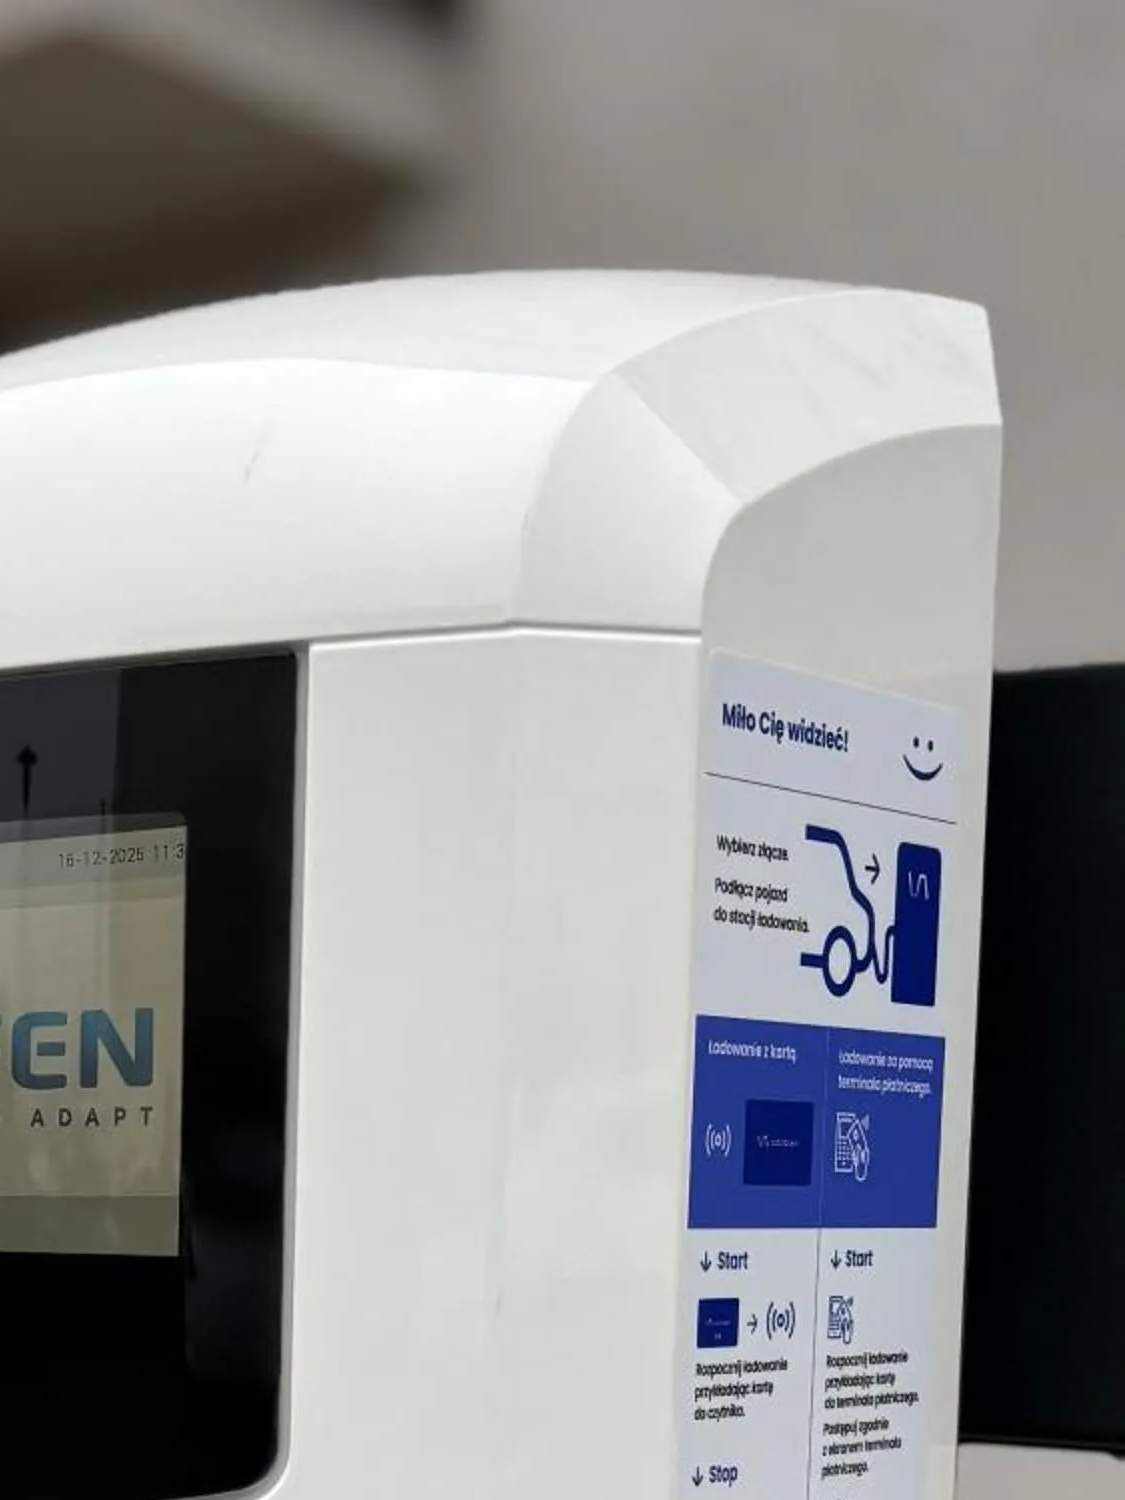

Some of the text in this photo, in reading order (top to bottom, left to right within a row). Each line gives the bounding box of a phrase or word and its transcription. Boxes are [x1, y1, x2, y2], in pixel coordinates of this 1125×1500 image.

[722, 702, 848, 753] Miło Cię widzieć!
[715, 876, 788, 905] Podłącz pojazd
[714, 905, 728, 922] do
[30, 1106, 153, 1128] ADAPT
[717, 1251, 749, 1271] Start
[844, 1249, 874, 1268] Start
[694, 1407, 706, 1421] do
[709, 1465, 738, 1487] Stop
